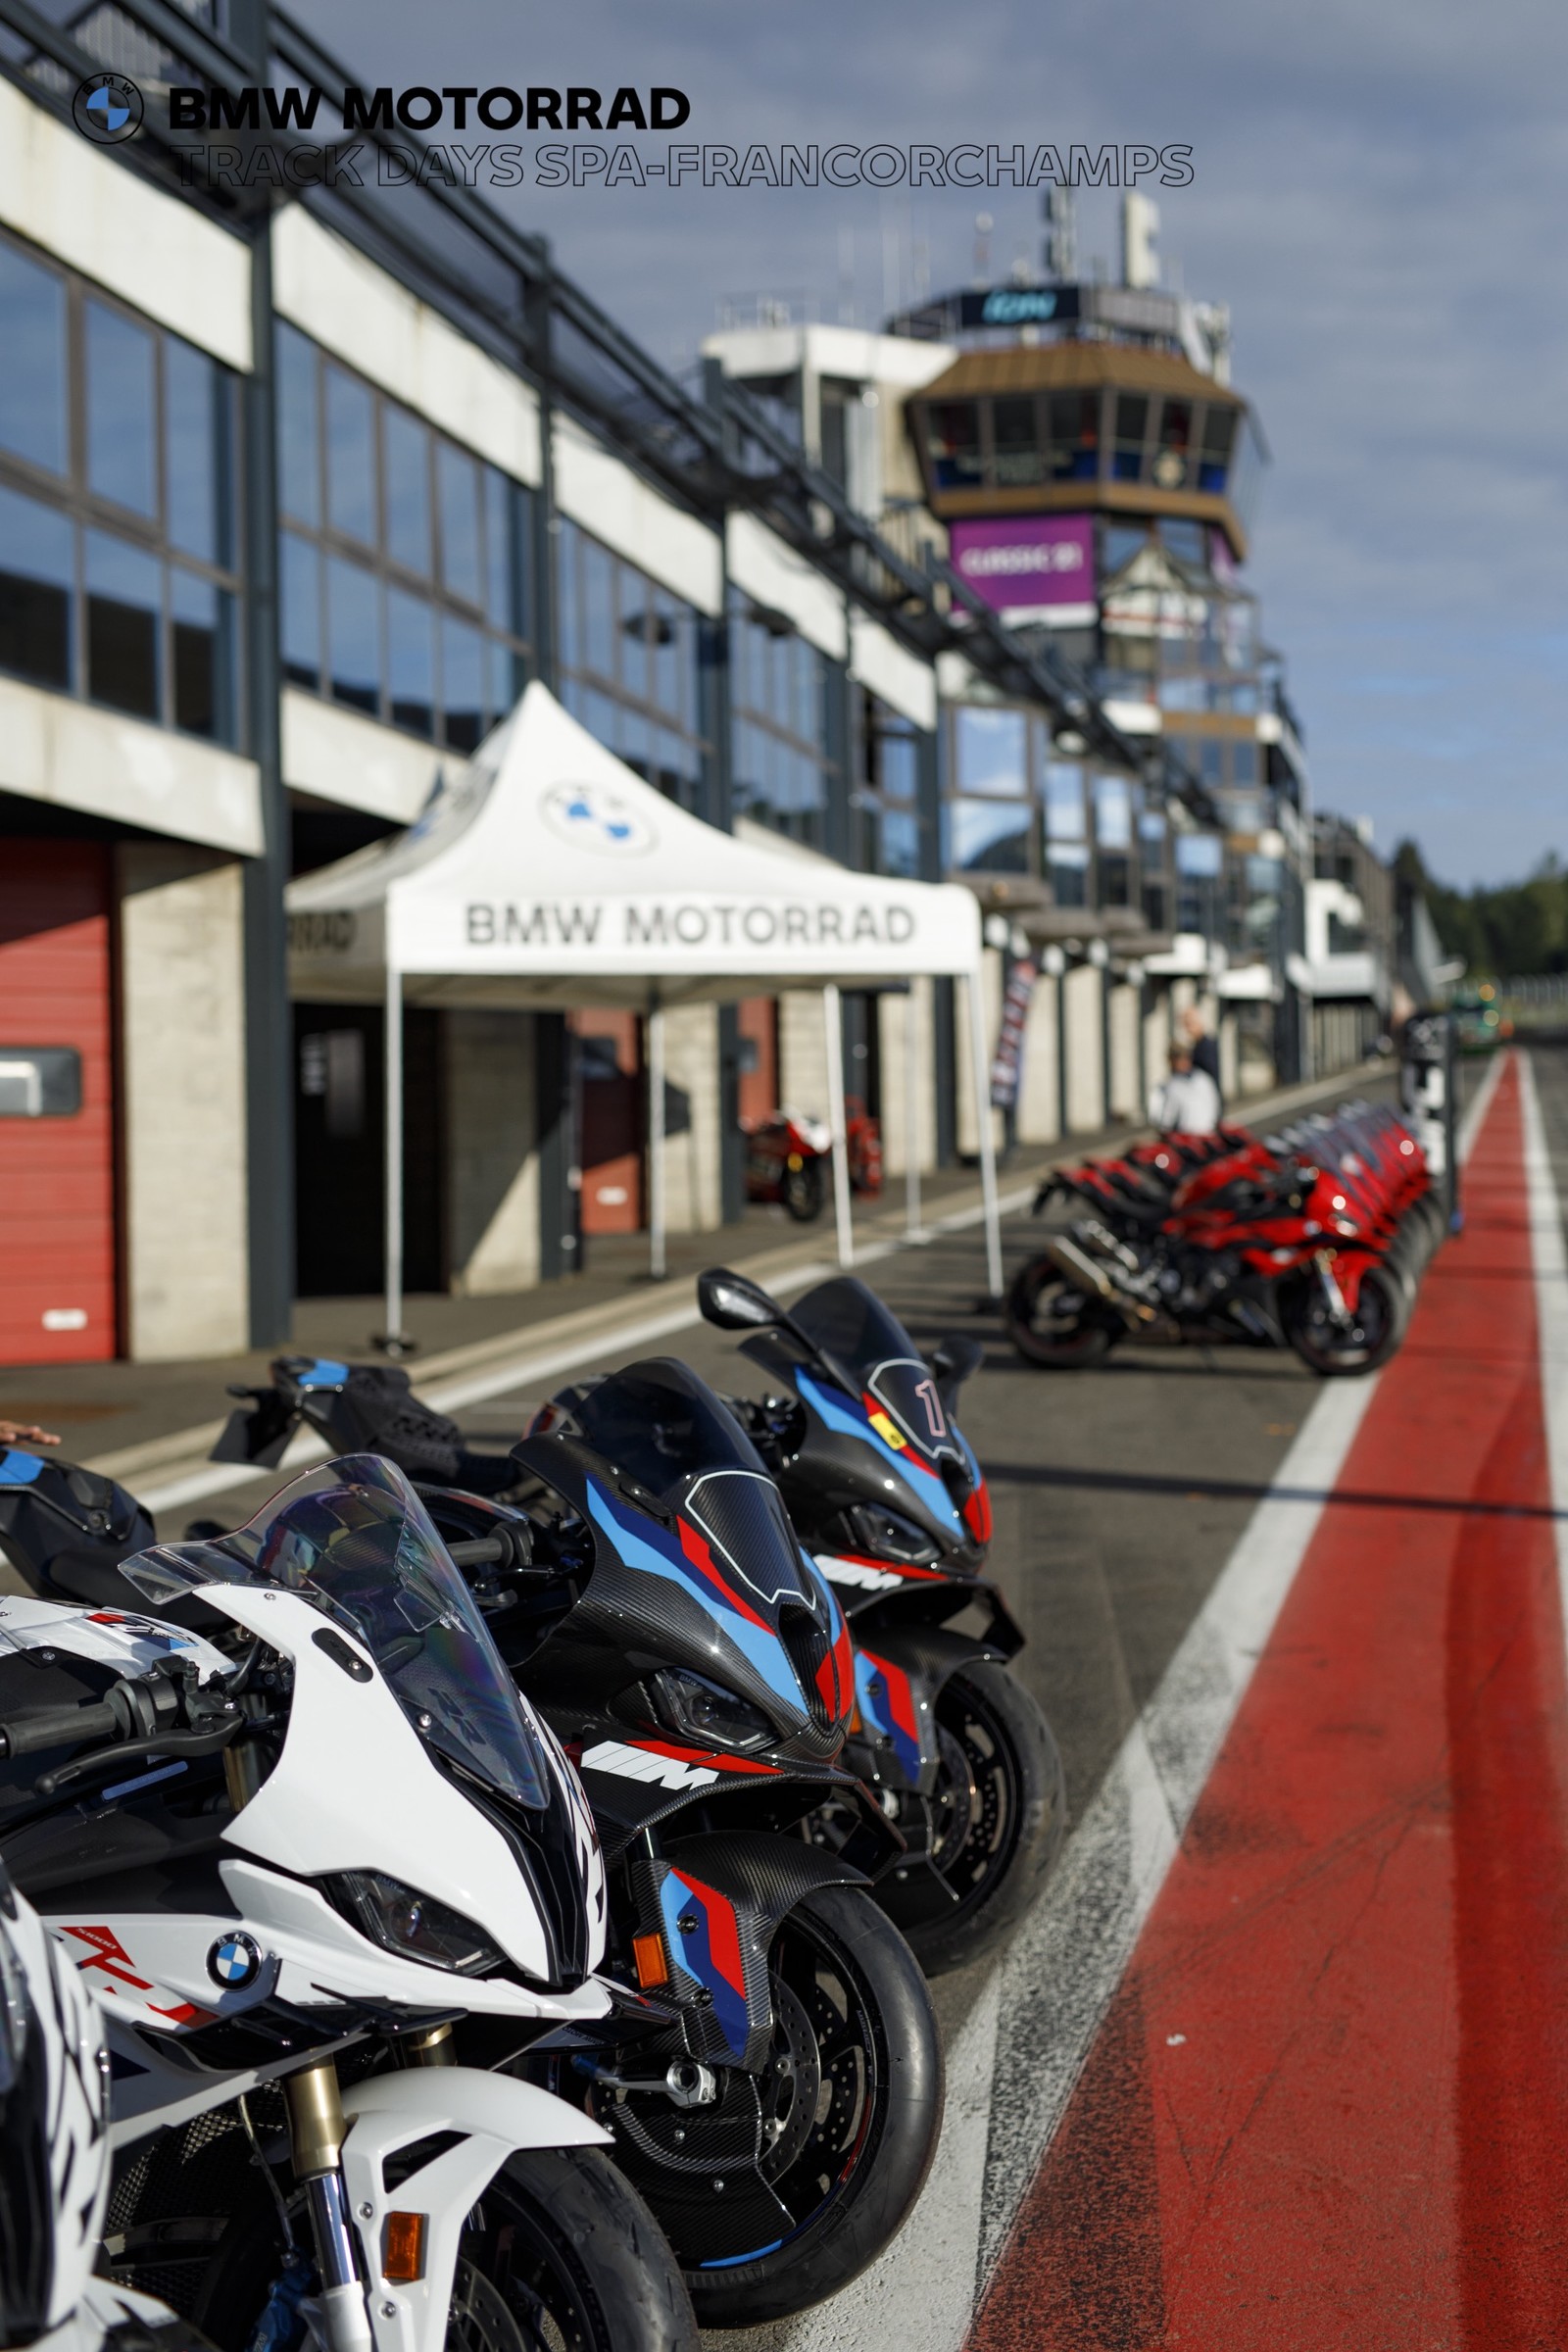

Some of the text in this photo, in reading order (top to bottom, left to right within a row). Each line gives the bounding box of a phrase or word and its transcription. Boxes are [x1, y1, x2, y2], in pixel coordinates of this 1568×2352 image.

[466, 904, 915, 946] BMW MOTORRAD
[914, 1379, 947, 1438] 1
[218, 1934, 257, 1957] BMW
